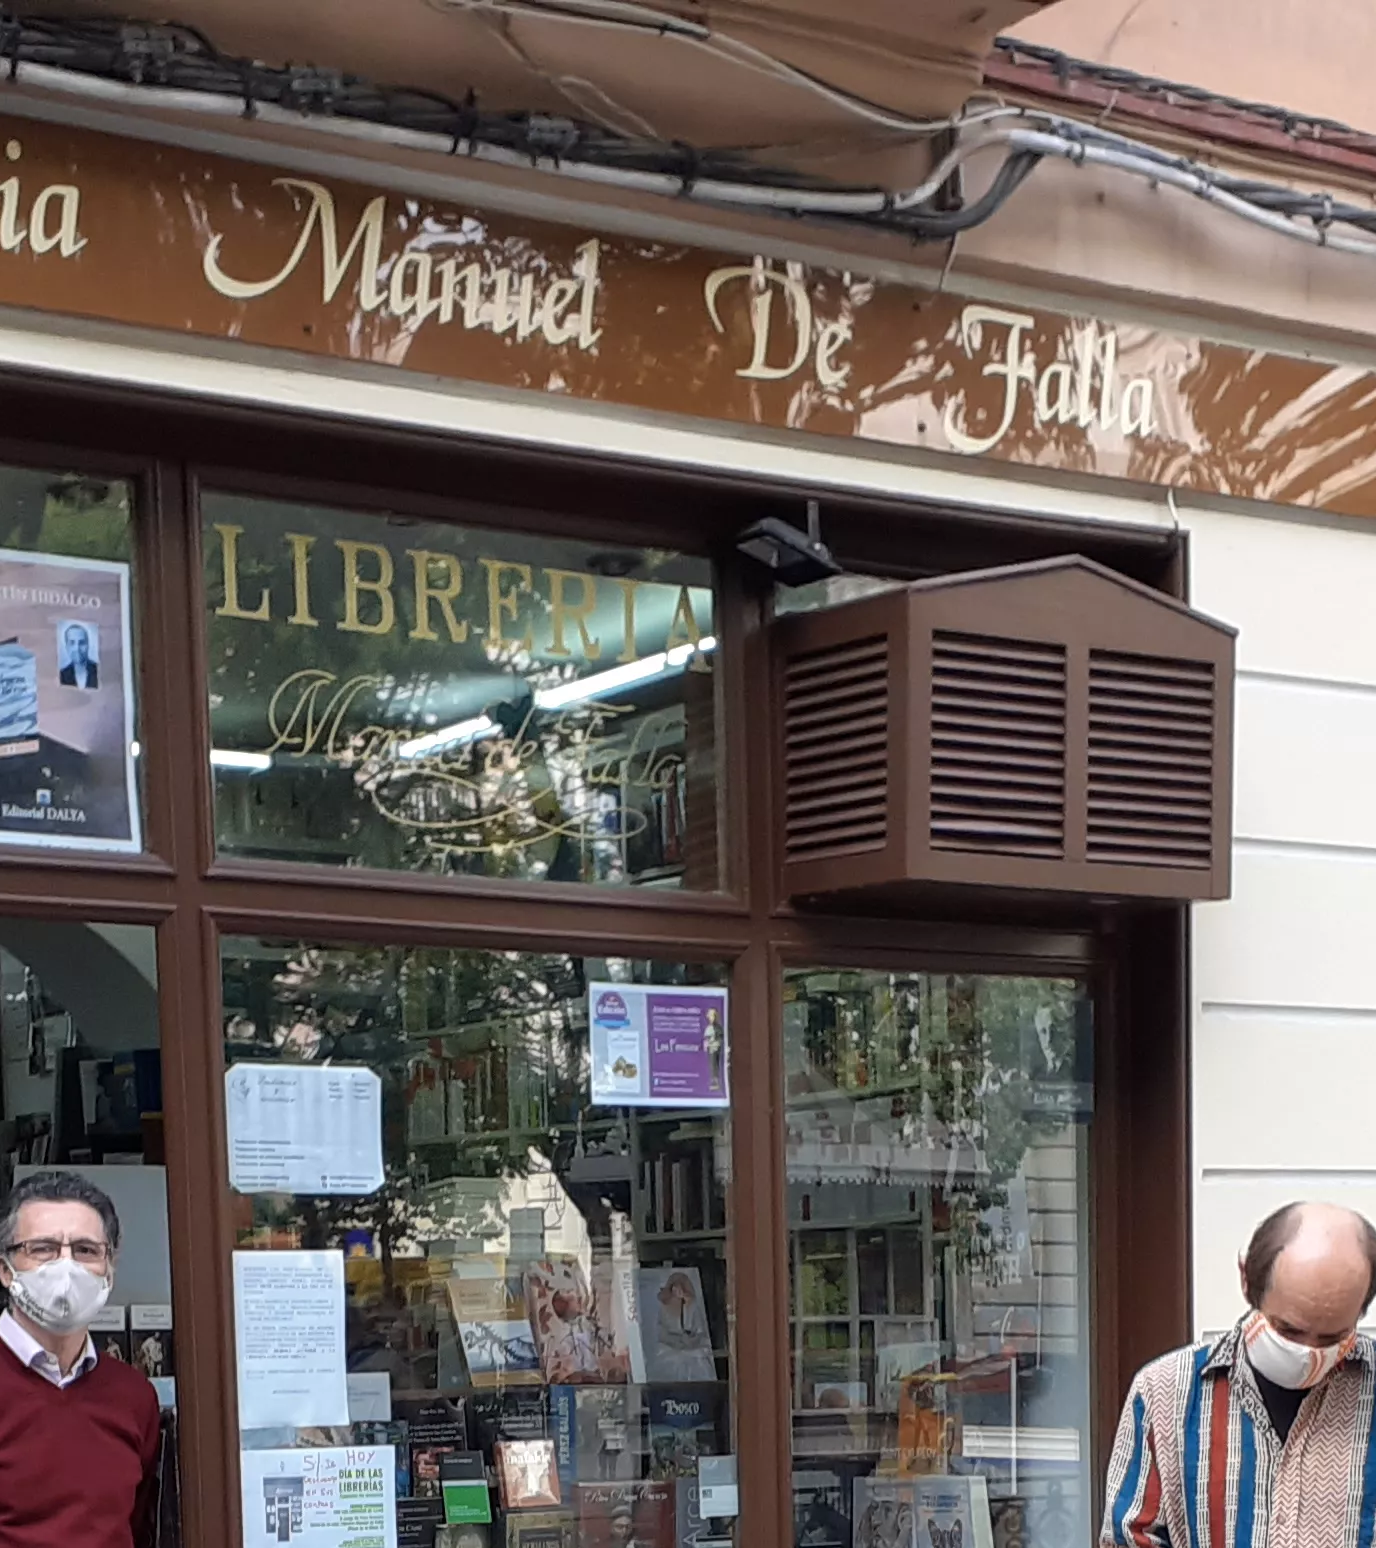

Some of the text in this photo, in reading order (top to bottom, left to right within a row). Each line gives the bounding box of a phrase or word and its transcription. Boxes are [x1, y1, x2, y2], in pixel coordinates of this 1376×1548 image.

[201, 176, 602, 351] Manuel
[703, 263, 852, 388] De
[943, 303, 1156, 456] Falla
[31, 588, 102, 610] HIDALGO
[355, 1468, 365, 1479] DE
[368, 1468, 384, 1479] LAS
[339, 1479, 384, 1493] LIBRERÍAS
